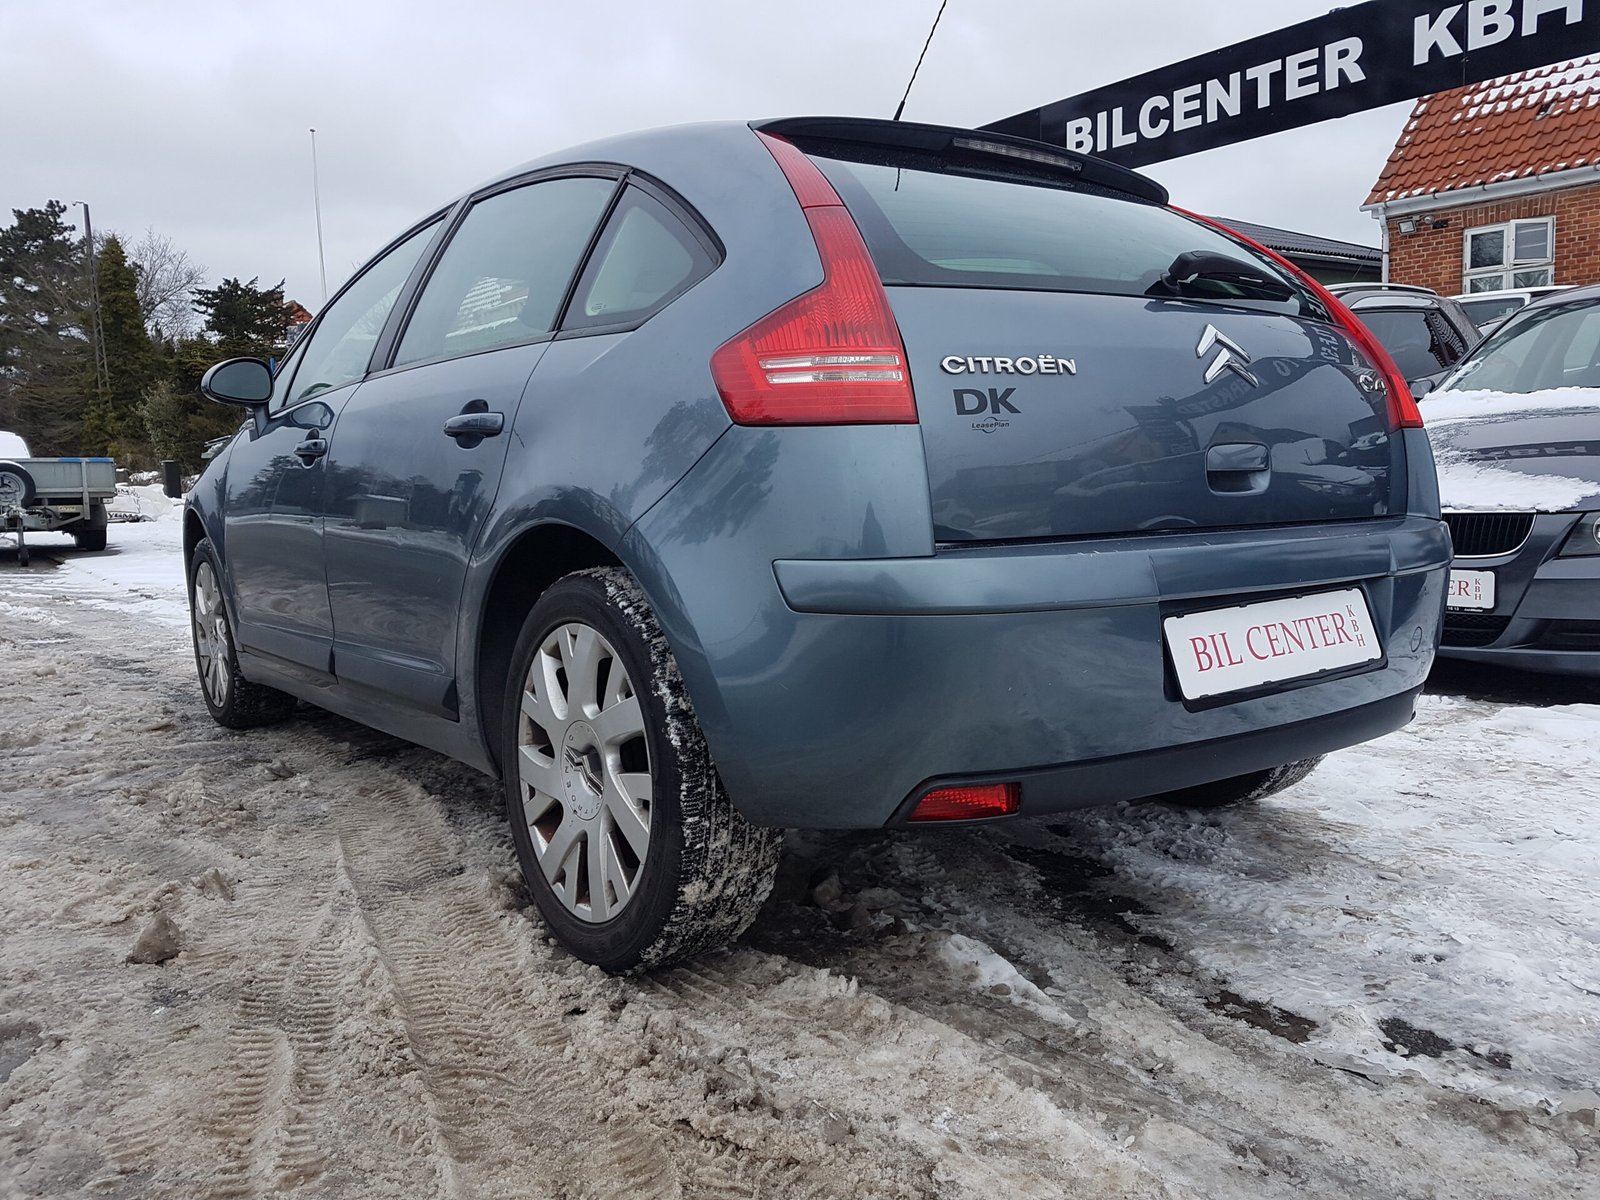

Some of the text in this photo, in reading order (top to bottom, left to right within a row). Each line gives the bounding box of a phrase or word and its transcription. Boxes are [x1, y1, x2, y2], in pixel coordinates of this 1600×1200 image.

[1066, 36, 1366, 154] BILCENTER
[940, 354, 1077, 375] CITROËN
[953, 388, 1021, 415] DK
[972, 420, 1010, 429] LeasePlan
[1189, 612, 1354, 672] BIL CENTER
